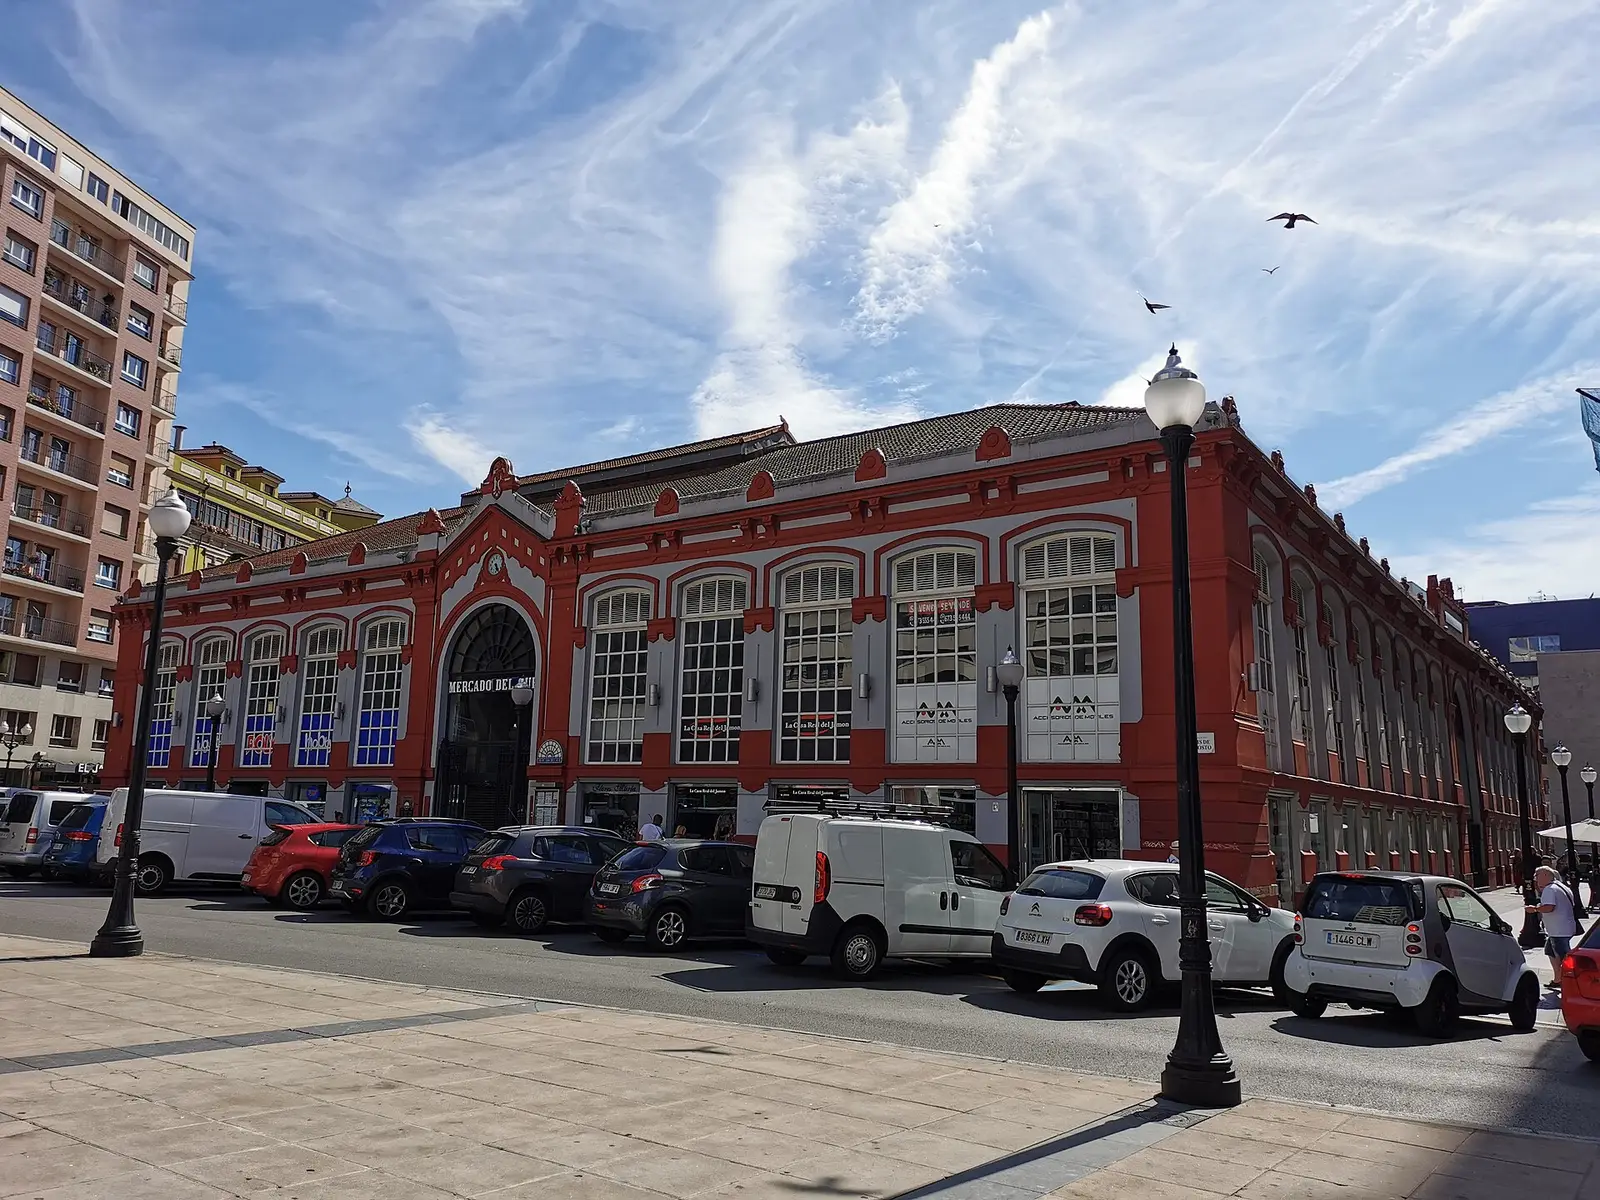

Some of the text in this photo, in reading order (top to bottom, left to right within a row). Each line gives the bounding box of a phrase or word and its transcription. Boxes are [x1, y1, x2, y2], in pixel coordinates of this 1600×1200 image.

[449, 680, 492, 693] MERCADO
[496, 678, 514, 690] DEL
[722, 724, 741, 733] Jmon
[829, 721, 850, 730] Jmon
[78, 763, 90, 773] EL
[1335, 934, 1354, 945] 1446
